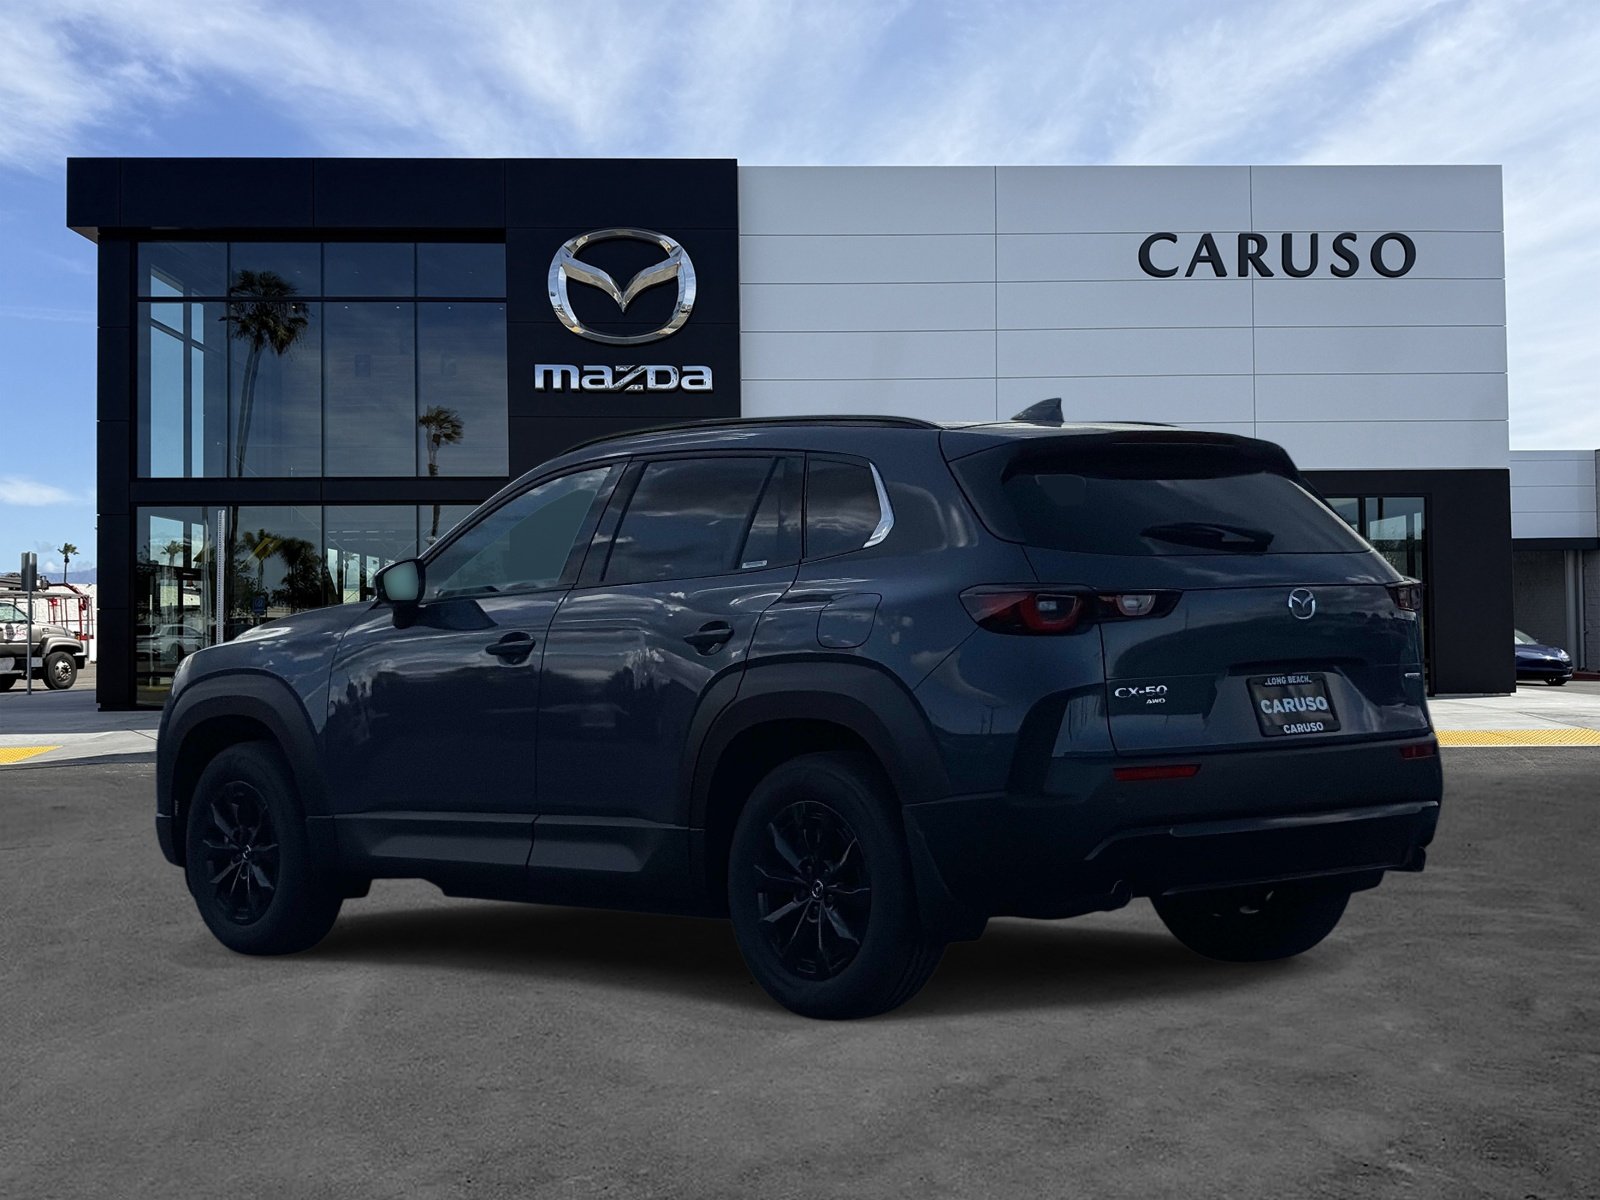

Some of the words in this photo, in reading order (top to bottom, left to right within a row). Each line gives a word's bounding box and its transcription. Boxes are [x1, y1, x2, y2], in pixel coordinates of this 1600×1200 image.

[1138, 232, 1417, 278] CARUSO
[1267, 677, 1287, 685] LONG
[1114, 685, 1168, 698] CX-50
[1260, 696, 1328, 714] CARUSO
[1283, 722, 1324, 734] CARUSO
